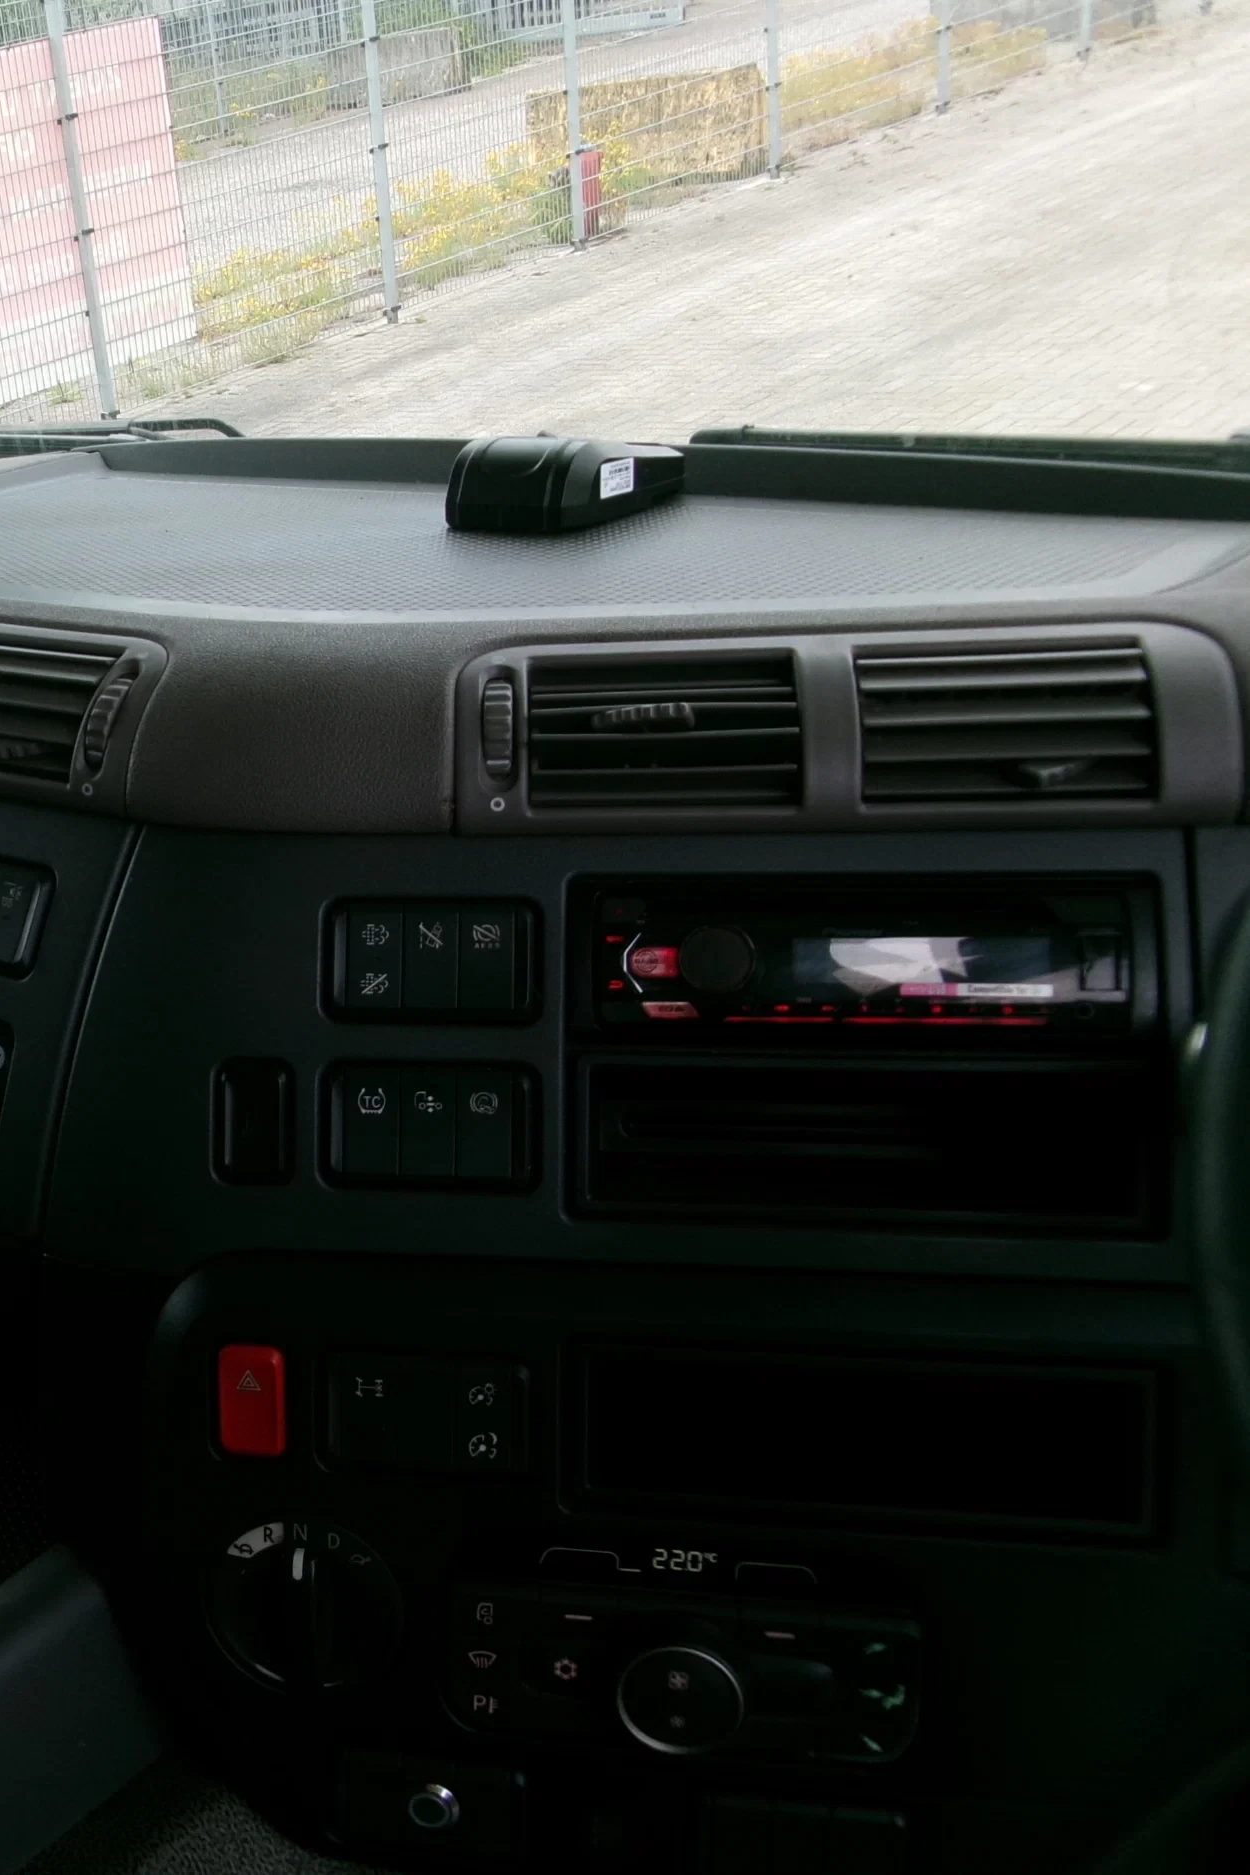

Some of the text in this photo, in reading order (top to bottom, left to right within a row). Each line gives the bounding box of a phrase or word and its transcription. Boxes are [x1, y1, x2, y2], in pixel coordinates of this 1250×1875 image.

[362, 1095, 381, 1109] TC
[263, 1522, 341, 1549] R N D
